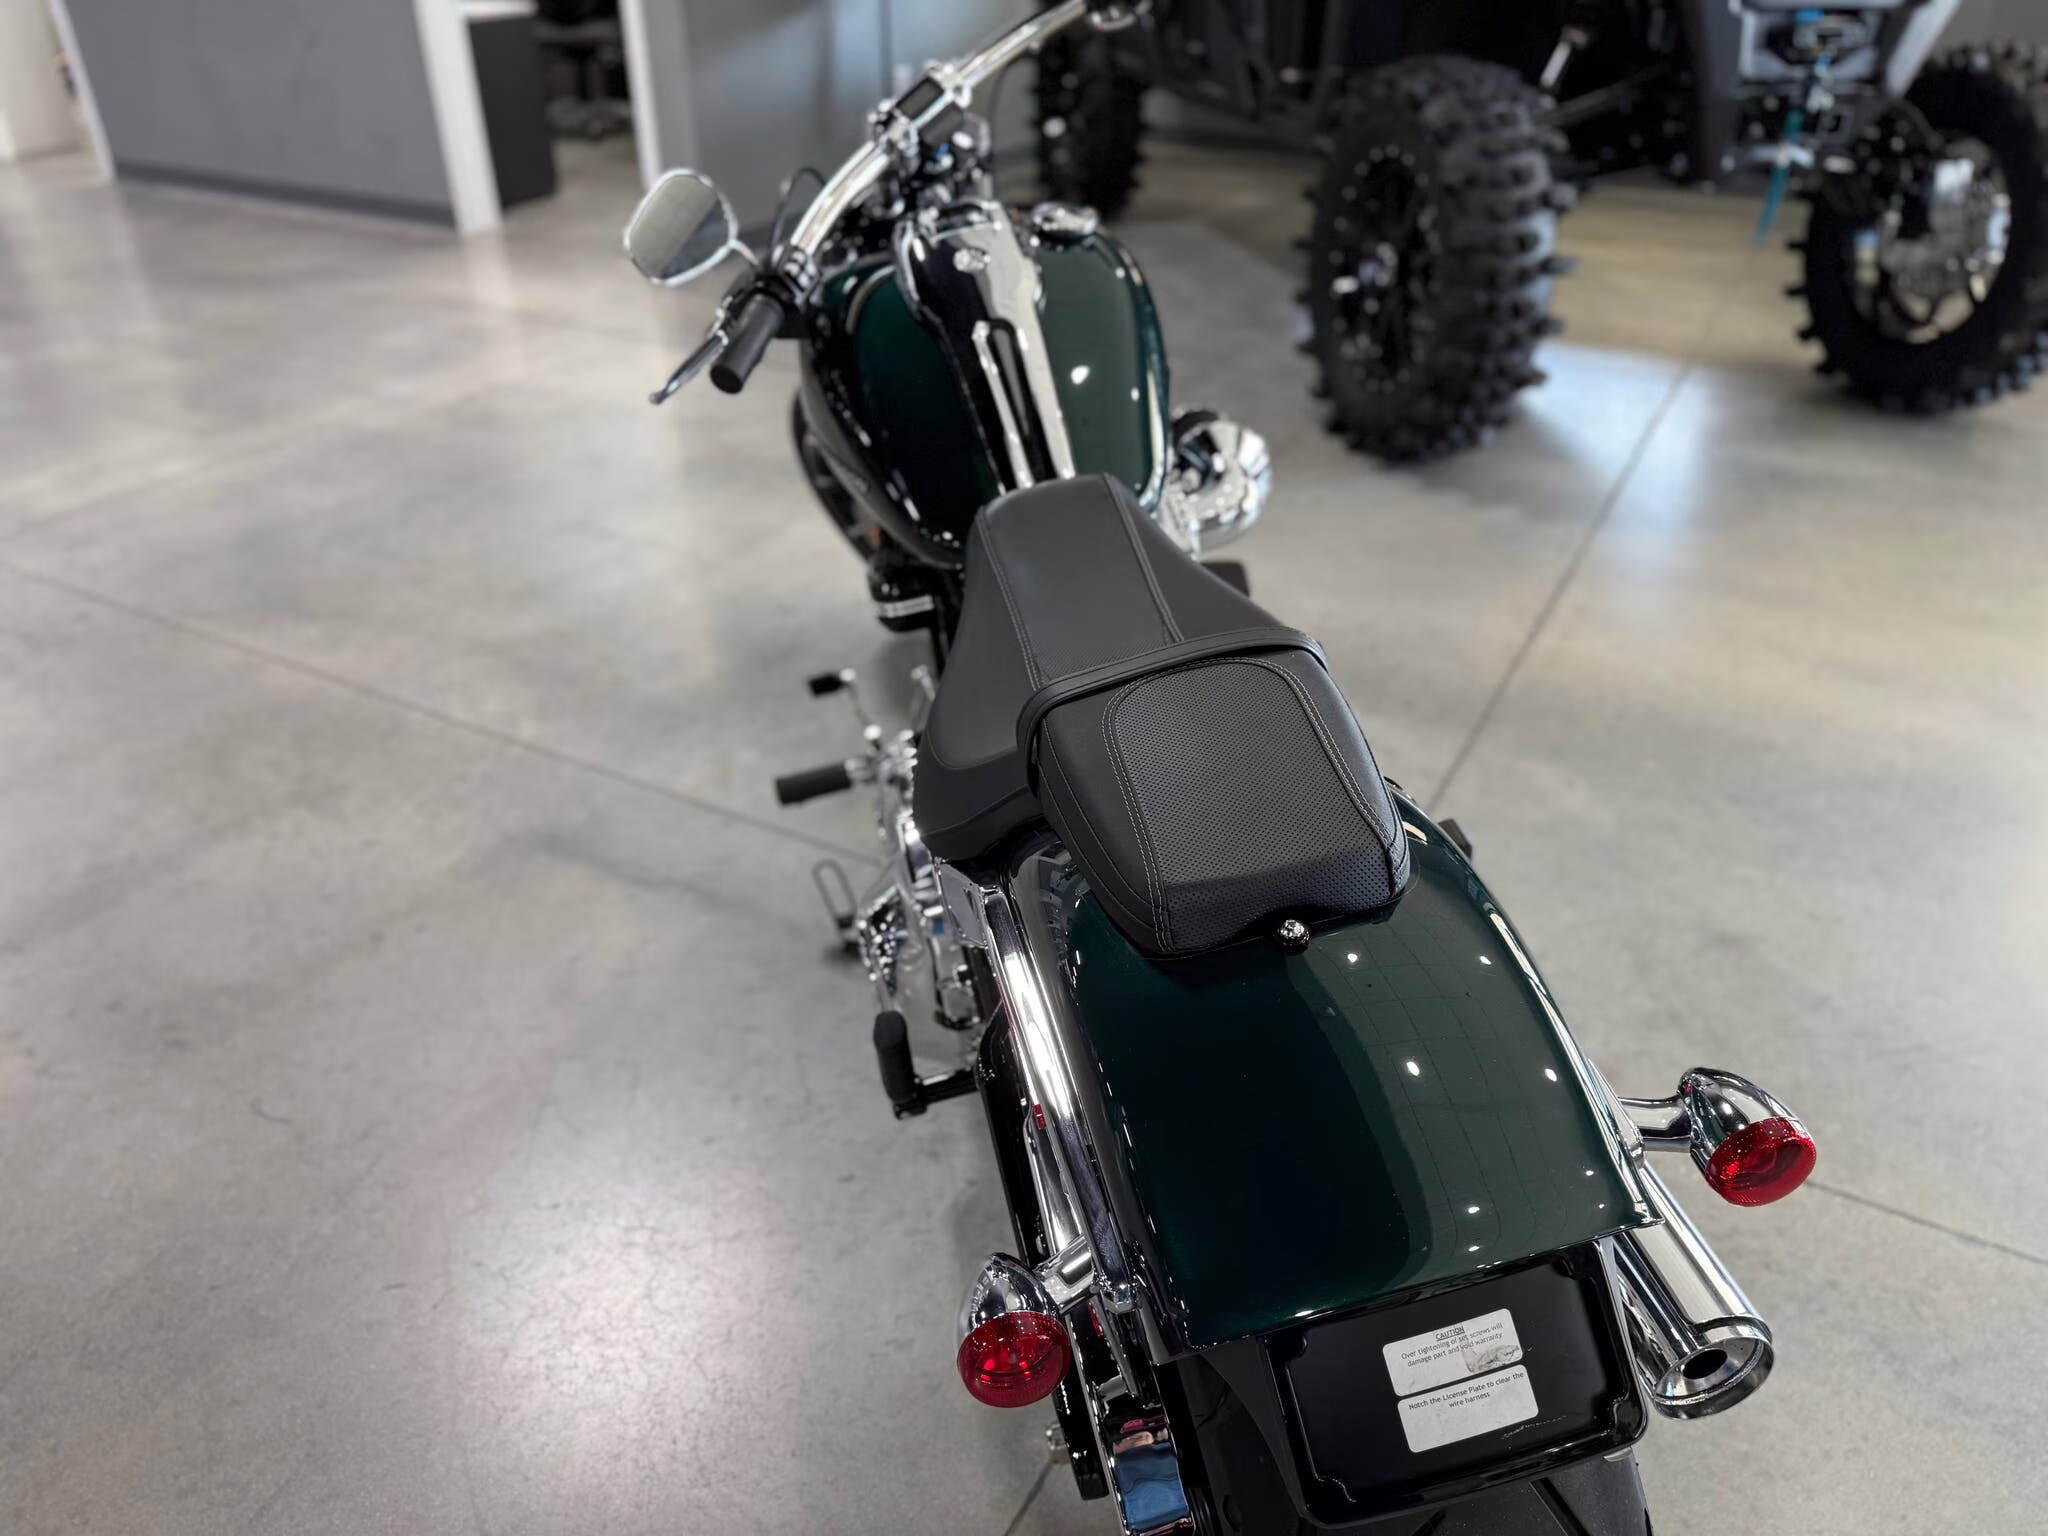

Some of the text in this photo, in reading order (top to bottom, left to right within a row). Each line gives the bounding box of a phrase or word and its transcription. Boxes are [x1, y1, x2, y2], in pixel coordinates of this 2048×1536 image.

[1401, 1322, 1503, 1360] Over tightening of set screws will
[1407, 1355, 1432, 1366] damage
[1433, 1351, 1447, 1361] part
[1448, 1346, 1459, 1356] and
[1475, 1332, 1502, 1345] warranty
[1435, 1326, 1465, 1340] CAUTION
[1409, 1400, 1429, 1410] Notch
[1430, 1396, 1441, 1404] the
[1442, 1389, 1467, 1401] License
[1469, 1383, 1485, 1394] Plate
[1495, 1376, 1512, 1386] clear
[1512, 1372, 1524, 1380] the
[1449, 1392, 1490, 1408] wire harness
